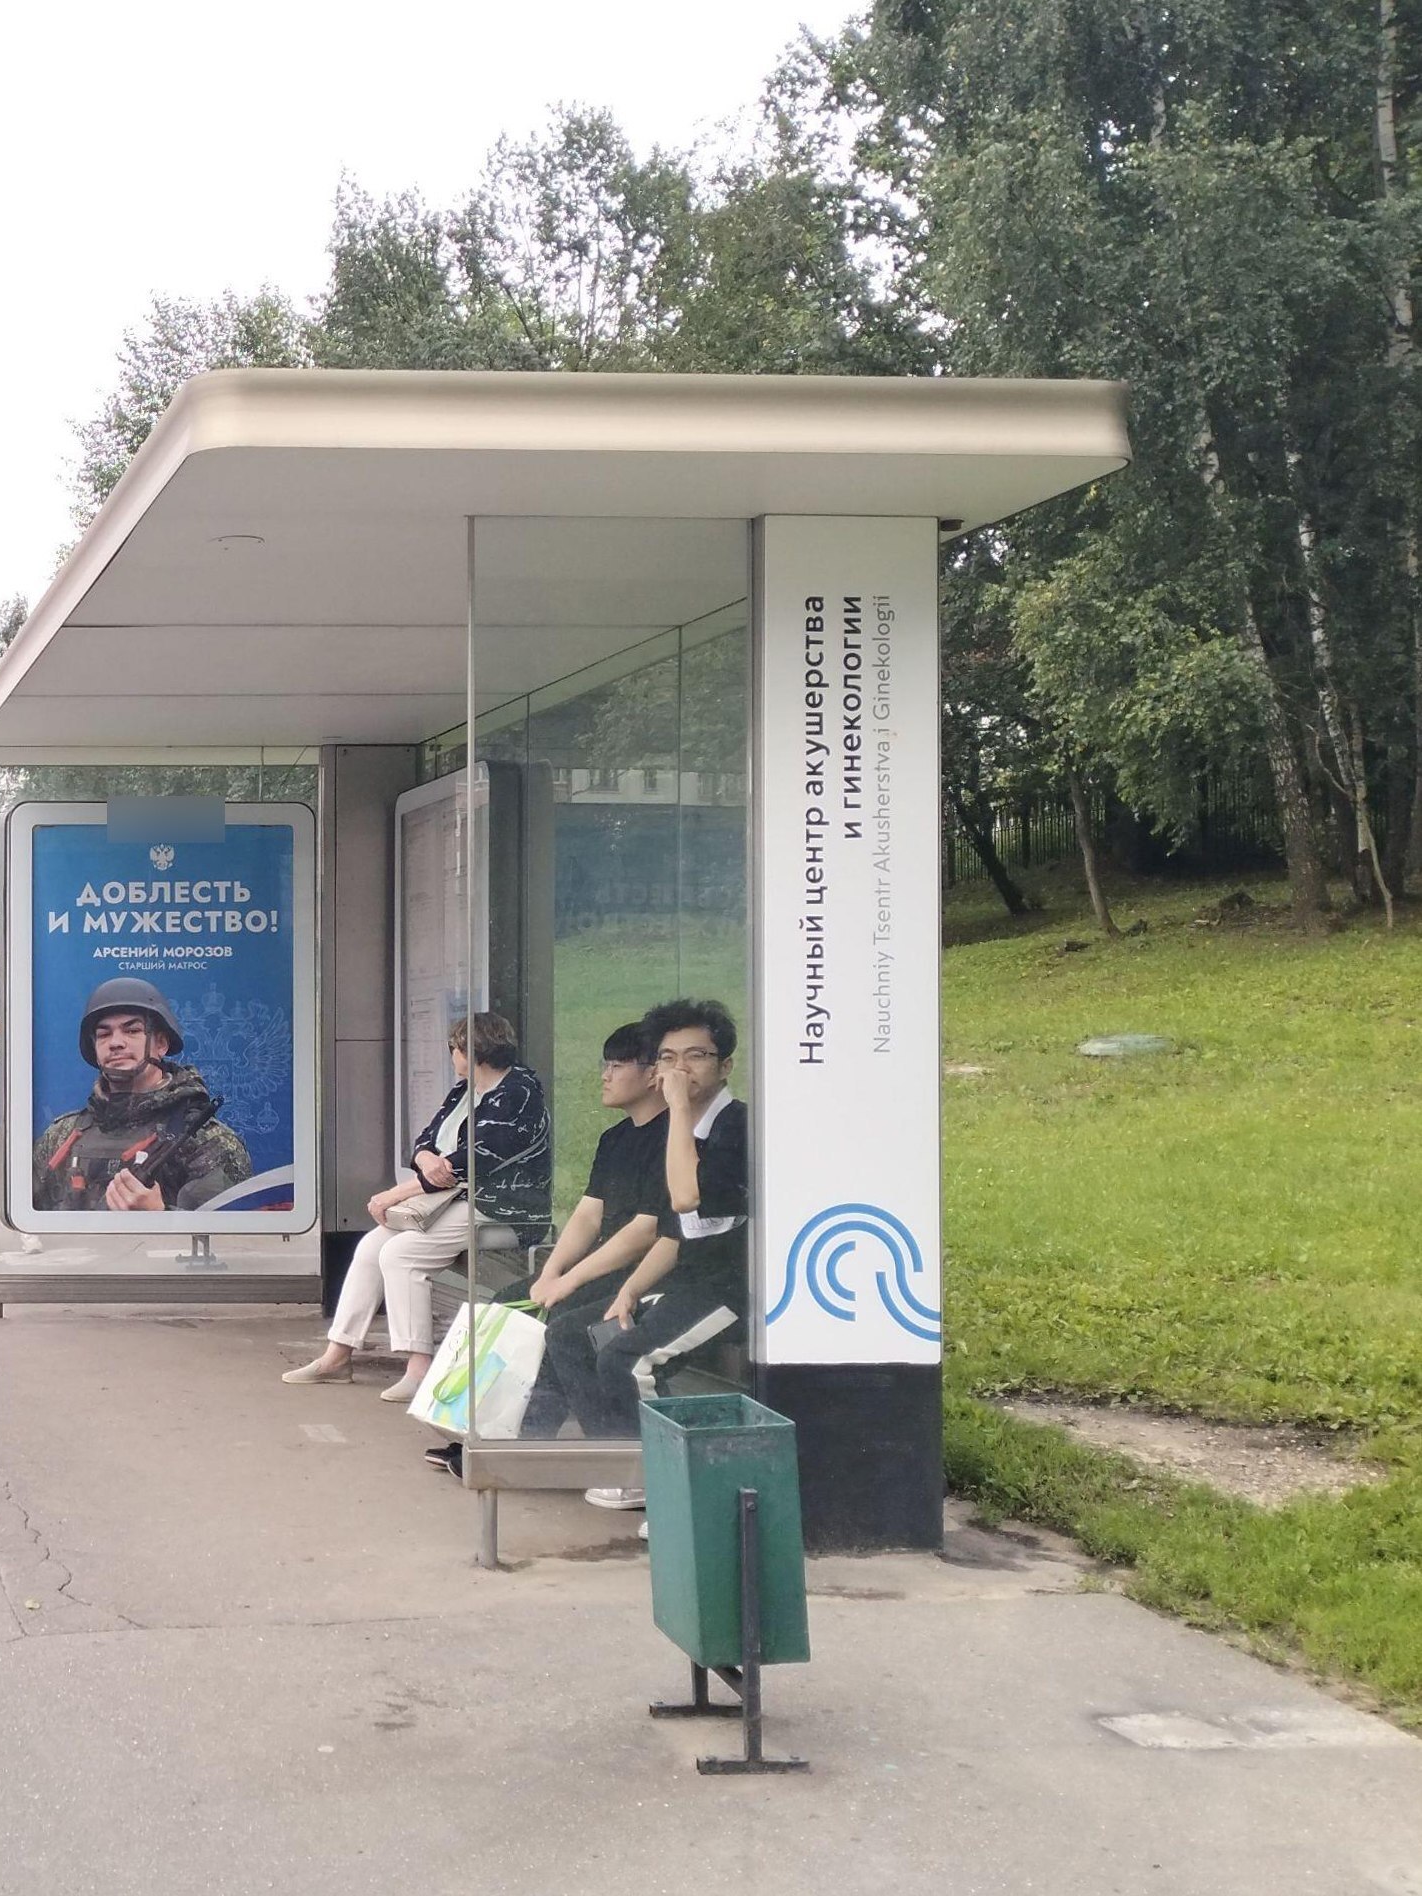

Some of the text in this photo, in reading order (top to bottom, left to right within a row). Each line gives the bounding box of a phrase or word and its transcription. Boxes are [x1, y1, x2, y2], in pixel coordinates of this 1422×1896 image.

[872, 596, 895, 720] Ginekologii
[843, 596, 862, 839] и гинекологии
[799, 596, 830, 1064] Научный центр акушерства
[872, 741, 891, 873] Akusherstva
[48, 910, 278, 934] И МУЖЕСТВО!
[75, 880, 251, 908] ДОБЛЕСТЬ
[872, 878, 891, 946] Tsentr
[93, 943, 233, 958] АРСЕНИЙ МОРОЗОВ
[118, 960, 208, 970] СТАРШИЙ МАТРОС
[872, 951, 895, 1054] Nauchniy
